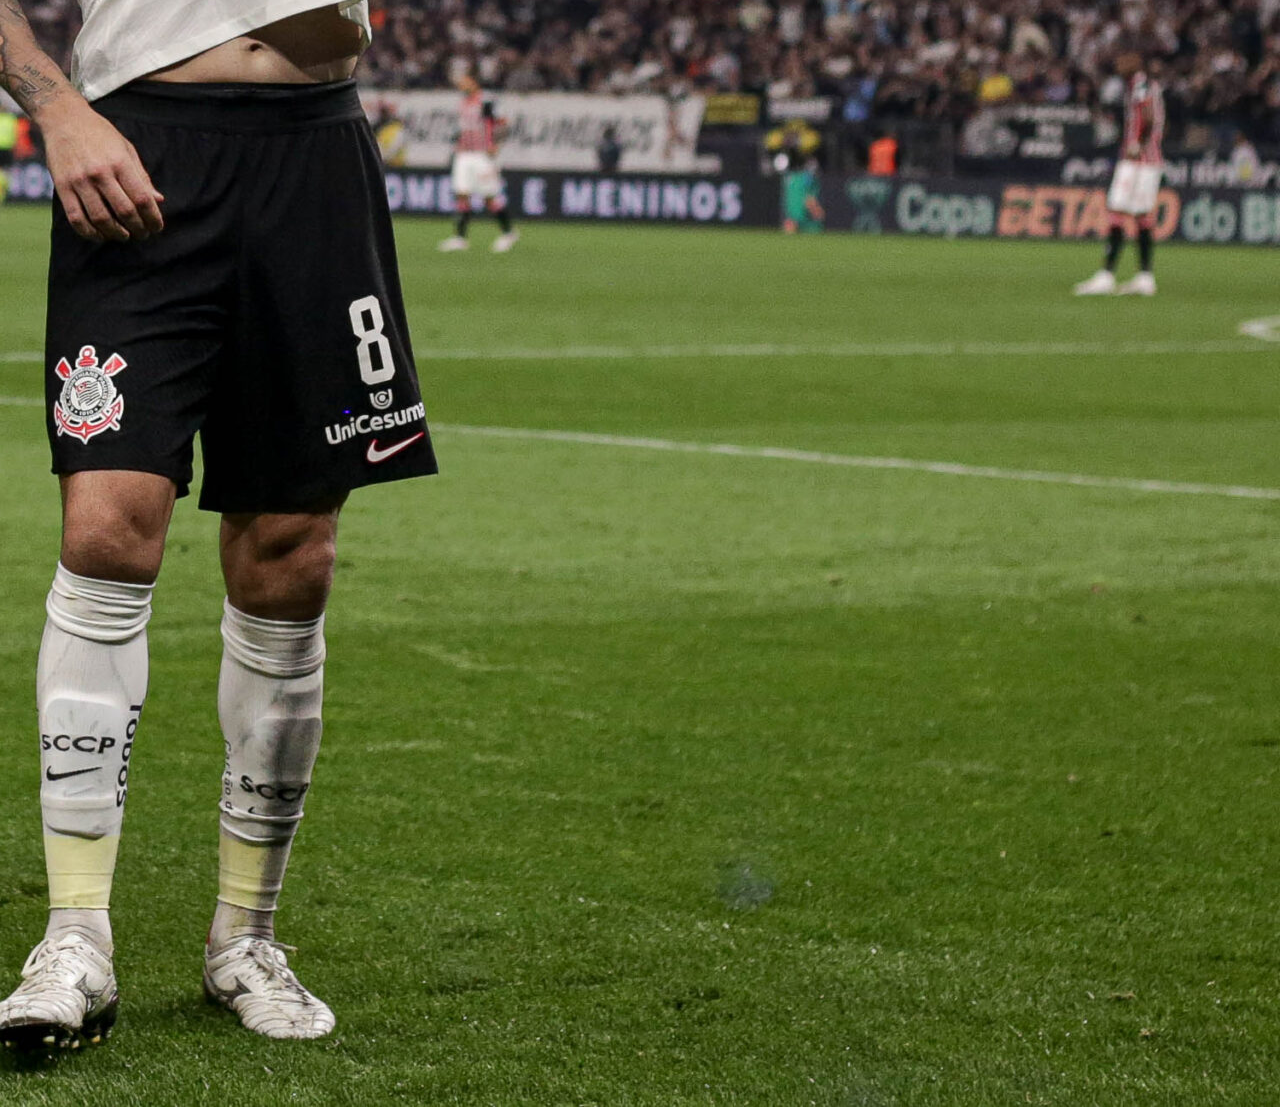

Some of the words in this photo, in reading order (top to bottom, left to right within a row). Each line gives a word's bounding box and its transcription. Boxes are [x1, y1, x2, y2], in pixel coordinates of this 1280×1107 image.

[523, 177, 547, 216] E
[561, 179, 743, 221] MENINOS
[895, 183, 996, 238] Copa
[1181, 195, 1238, 242] do
[348, 294, 396, 385] 8
[41, 734, 116, 754] SCCP
